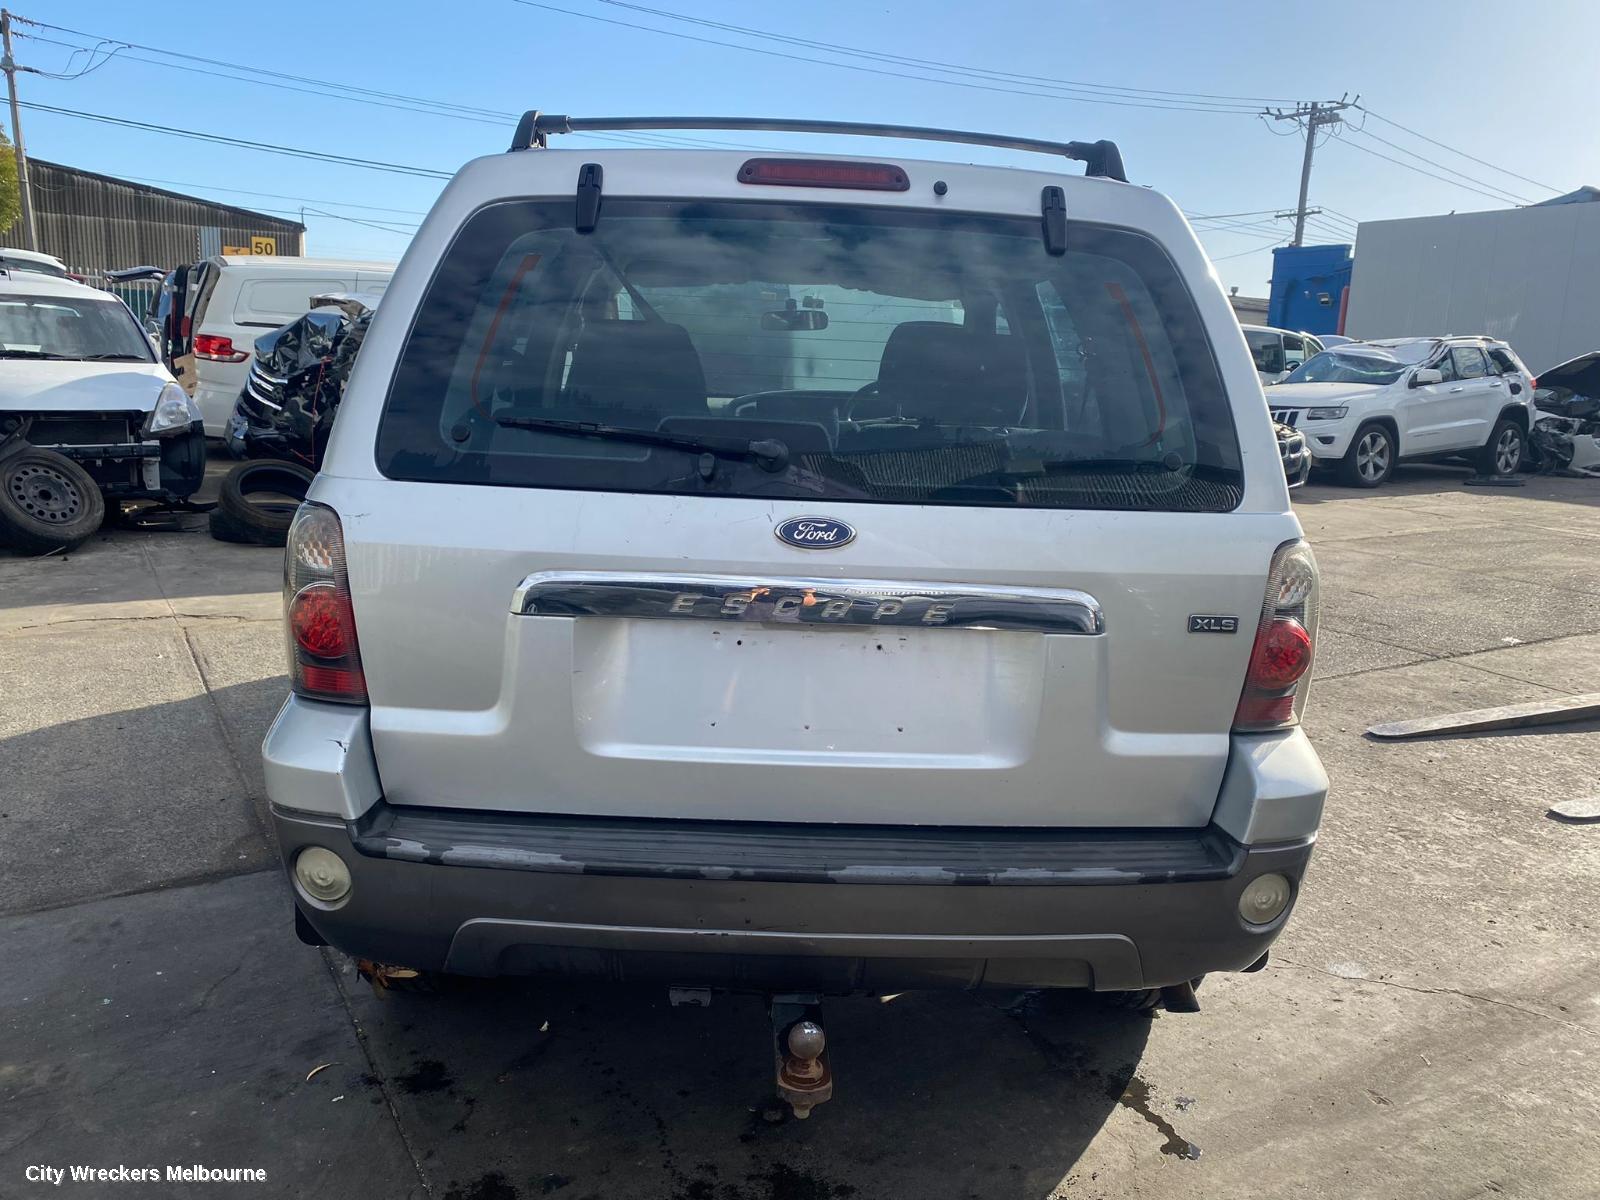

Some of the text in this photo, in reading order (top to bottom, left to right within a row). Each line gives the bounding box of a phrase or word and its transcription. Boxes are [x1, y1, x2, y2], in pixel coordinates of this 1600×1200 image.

[254, 242, 273, 255] 50
[793, 521, 837, 541] Ford
[671, 592, 956, 624] ESCAPE
[1193, 618, 1235, 631] XLS
